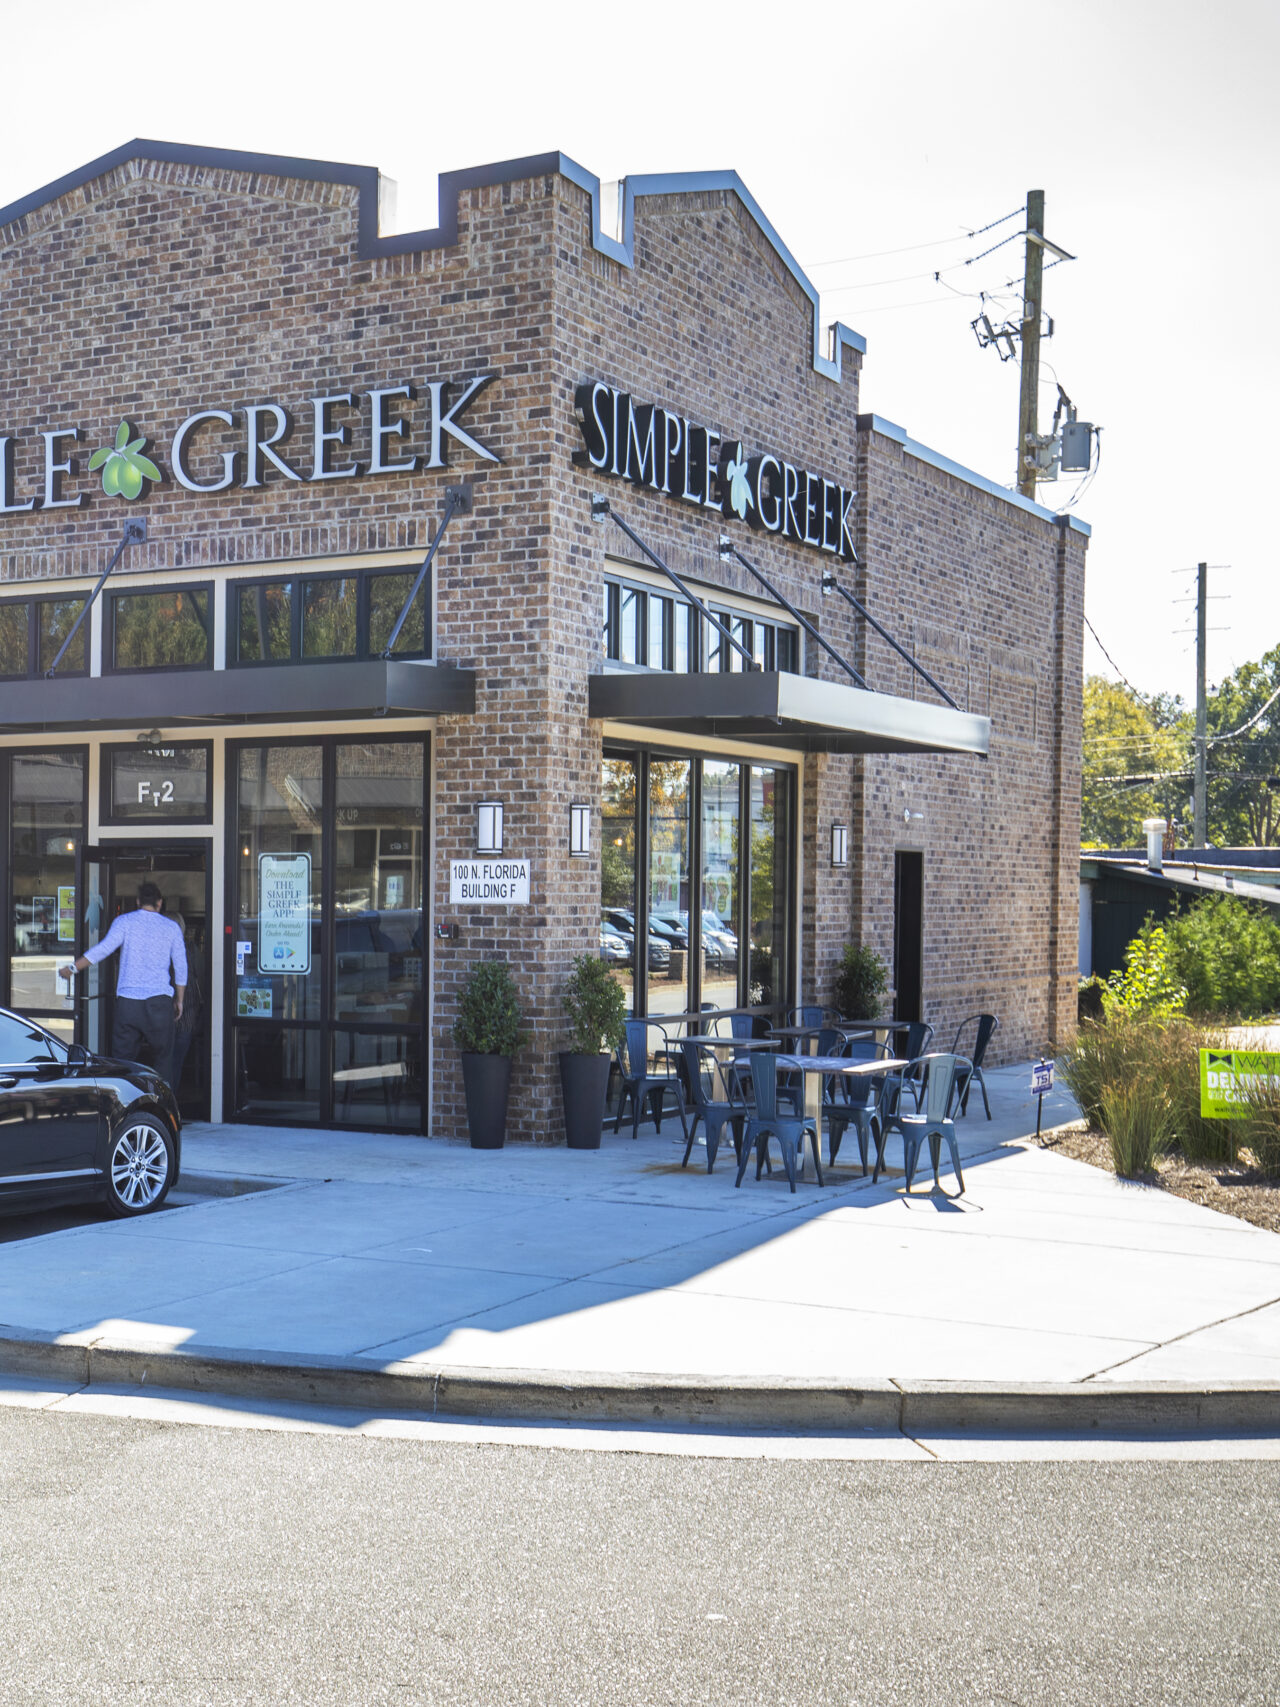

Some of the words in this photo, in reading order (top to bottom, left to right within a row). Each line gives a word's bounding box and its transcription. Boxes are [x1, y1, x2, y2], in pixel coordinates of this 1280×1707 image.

[171, 374, 505, 493] GREEK
[586, 382, 723, 512] SIMPLE
[756, 454, 858, 562] GREEK
[454, 864, 469, 880] 100
[472, 864, 481, 880] N.
[483, 864, 527, 880] FLORIDA
[274, 880, 295, 890] THE
[462, 883, 508, 899] BUILDING
[510, 883, 517, 899] F
[267, 890, 302, 899] SIMPLE
[268, 900, 301, 909] GREEK
